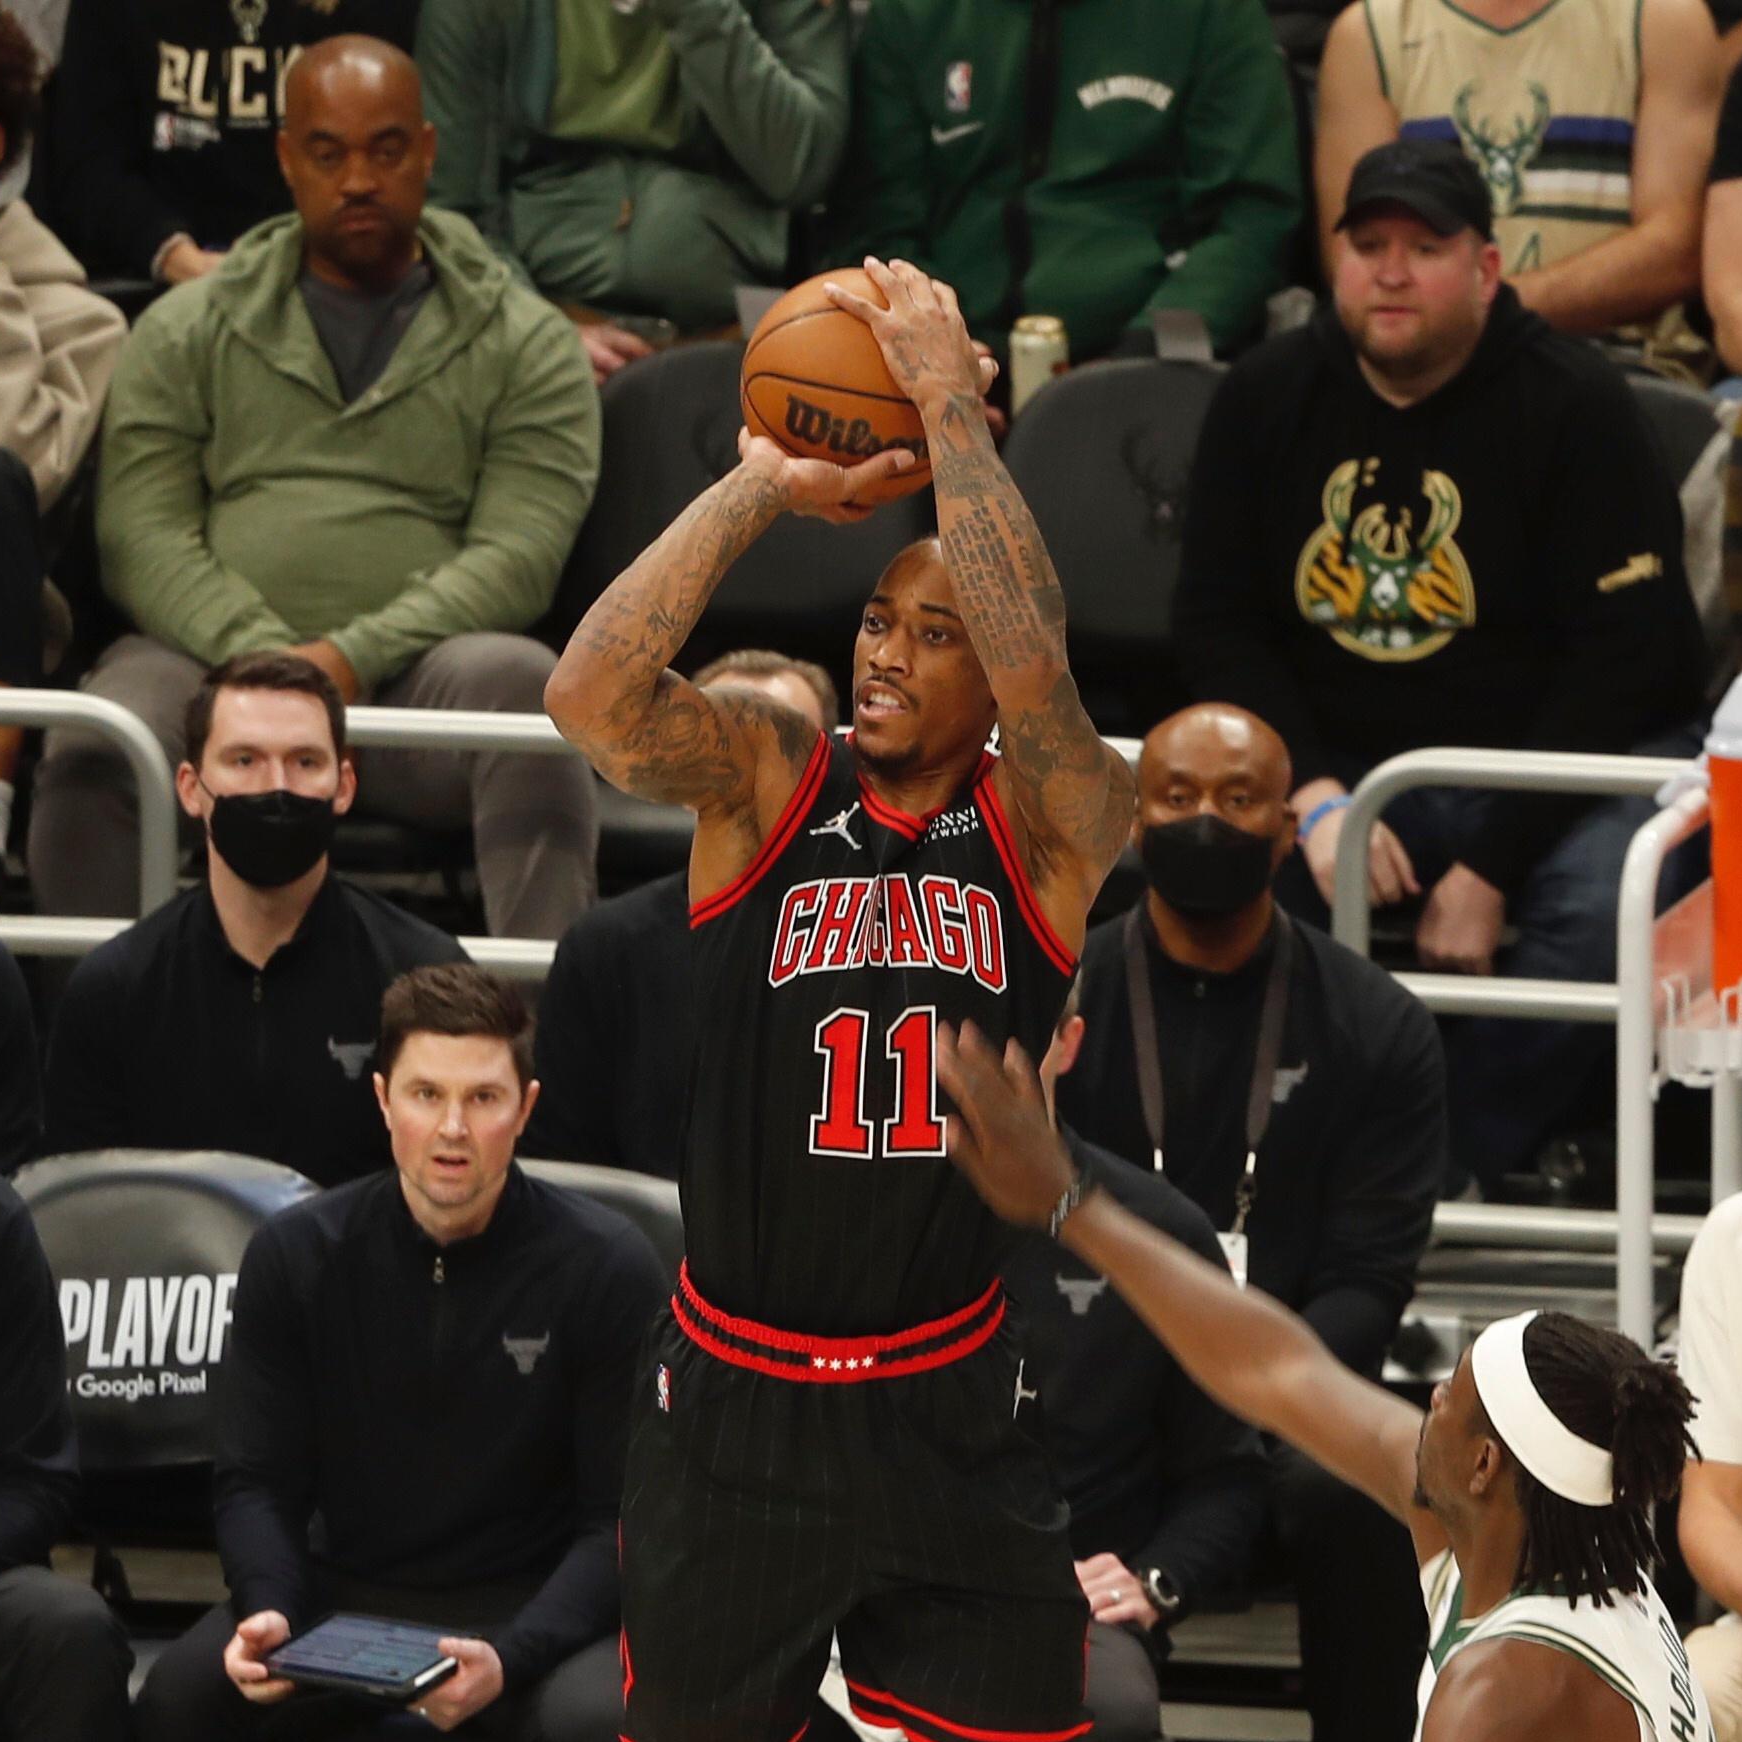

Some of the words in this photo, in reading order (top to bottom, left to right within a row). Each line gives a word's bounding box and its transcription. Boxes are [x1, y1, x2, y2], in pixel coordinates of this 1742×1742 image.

[768, 872, 1007, 994] CHICAGO
[809, 1006, 948, 1160] 11
[76, 1372, 156, 1402] Google
[160, 1369, 207, 1395] Pixel
